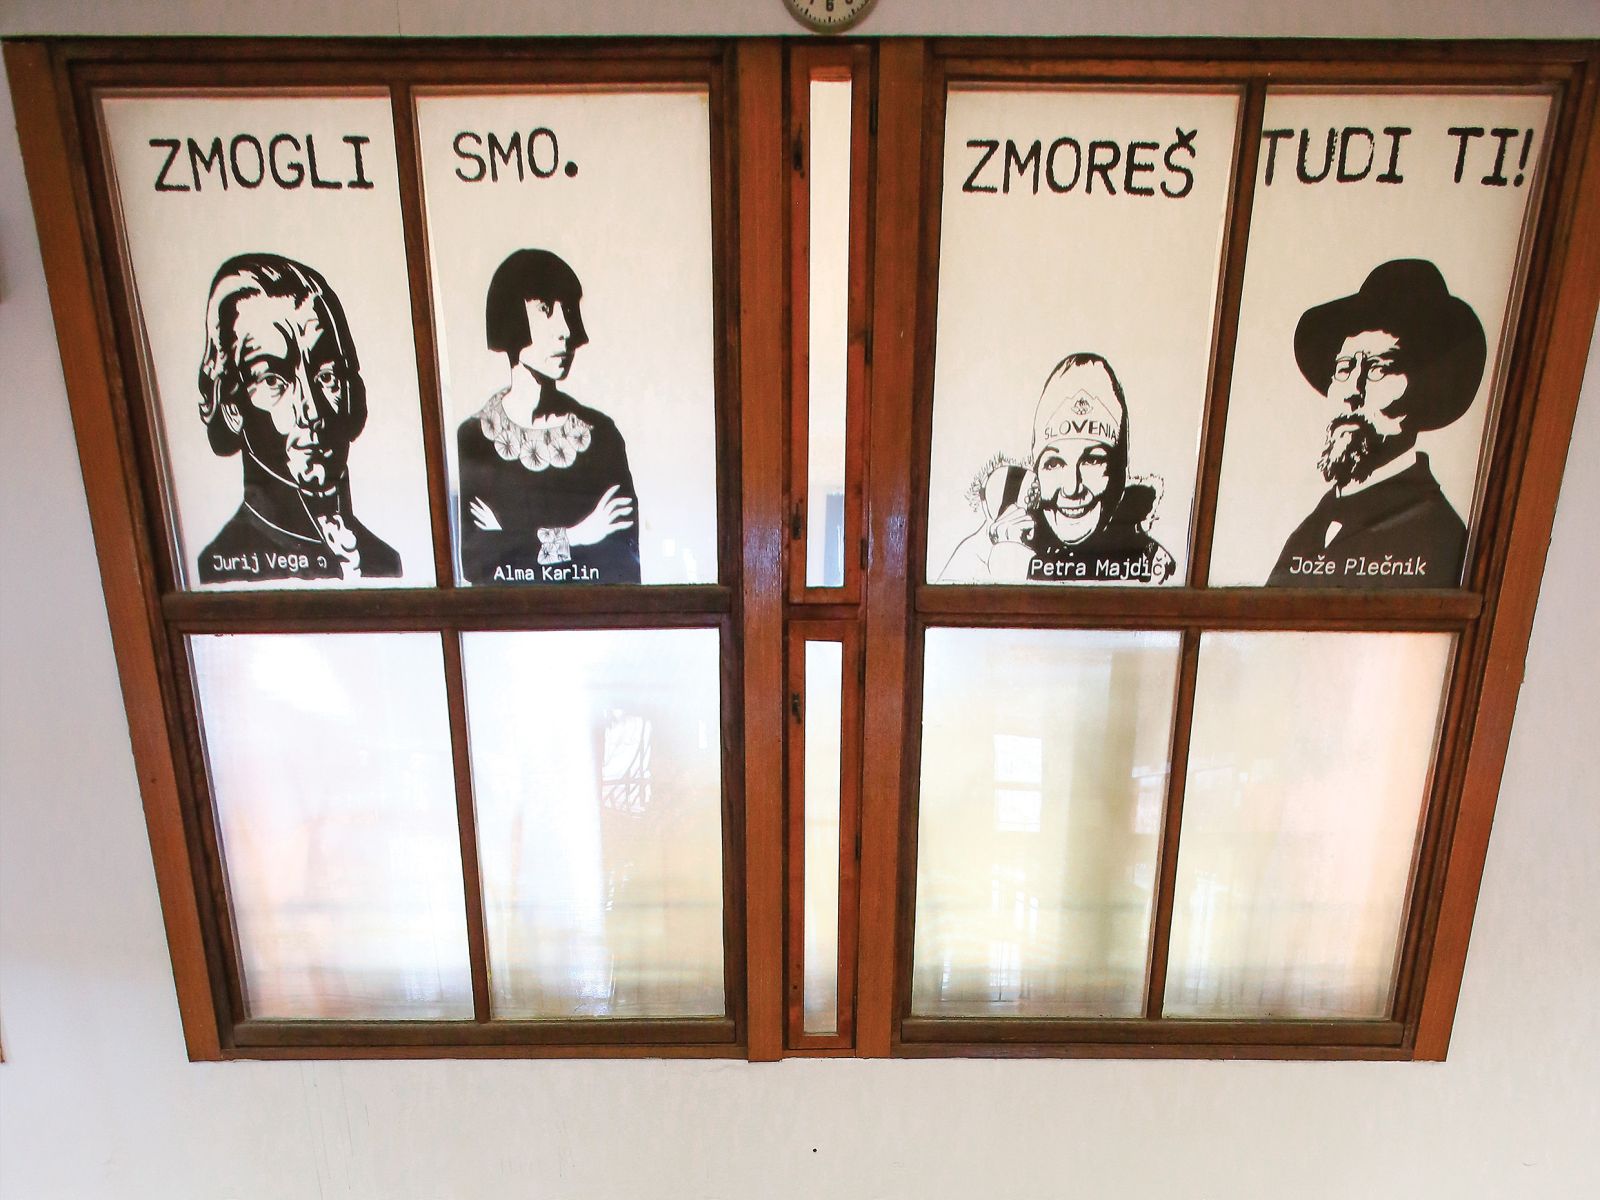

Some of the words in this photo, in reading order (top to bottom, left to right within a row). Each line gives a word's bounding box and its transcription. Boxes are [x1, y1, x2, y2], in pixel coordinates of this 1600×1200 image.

[149, 134, 374, 191] ZMOGLI
[453, 128, 579, 183] SMO.
[962, 127, 1198, 199] ZMOREŠ
[1261, 126, 1412, 187] TUDI
[1447, 127, 1534, 188] TI!
[1044, 419, 1117, 444] SLOVENIA
[212, 552, 260, 573] Jurij
[265, 553, 309, 572] Vega
[494, 564, 535, 581] Alma
[541, 564, 600, 581] Karlin
[1031, 559, 1086, 576] Petra
[1095, 556, 1164, 580] Majdič
[1289, 554, 1336, 575] Jože
[1344, 554, 1427, 576] Plečnik
